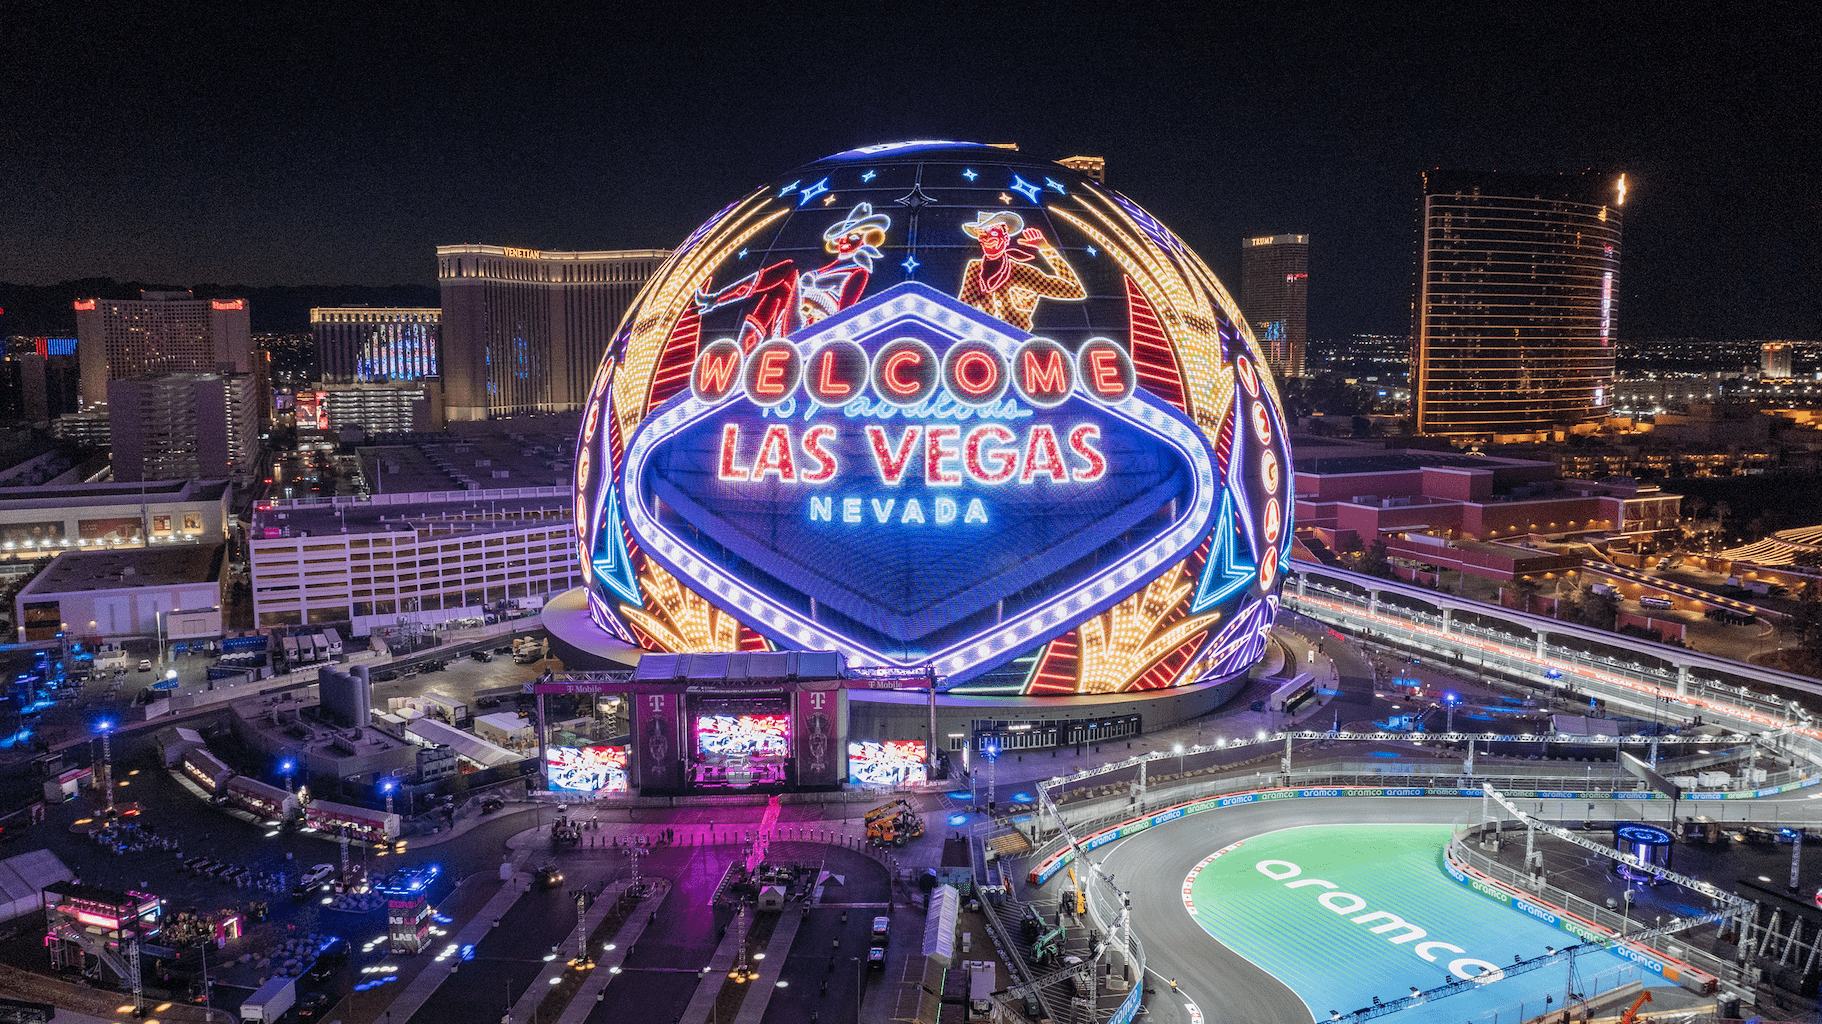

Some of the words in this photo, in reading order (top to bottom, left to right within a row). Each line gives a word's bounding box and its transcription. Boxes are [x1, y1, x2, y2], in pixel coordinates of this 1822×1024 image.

[1251, 236, 1273, 246] TRUMP
[503, 247, 540, 259] VENETIAN
[700, 351, 1125, 394] WELCOME
[718, 422, 838, 482] LAS
[864, 422, 1108, 487] VEGAS
[810, 497, 989, 525] NEVADA
[1499, 647, 1531, 660] VOLCAN
[877, 680, 902, 688] Mobile
[1595, 673, 1633, 687] VOLCAN
[576, 684, 601, 693] Mobile
[1707, 703, 1752, 719] VOLCAN
[1770, 718, 1819, 737] TEILA
[1262, 791, 1294, 799] aramco
[1386, 788, 1421, 796] aramco
[1187, 801, 1215, 814] aramco
[1222, 795, 1253, 806] aramco
[1155, 810, 1181, 824] aramco
[1123, 820, 1149, 835] aramco
[1091, 832, 1117, 847] aramco
[1043, 861, 1061, 880] aramco
[1472, 881, 1507, 902] aramco
[1517, 901, 1555, 923] aramco
[1256, 860, 1505, 984] aramco
[1618, 946, 1662, 972] aramco
